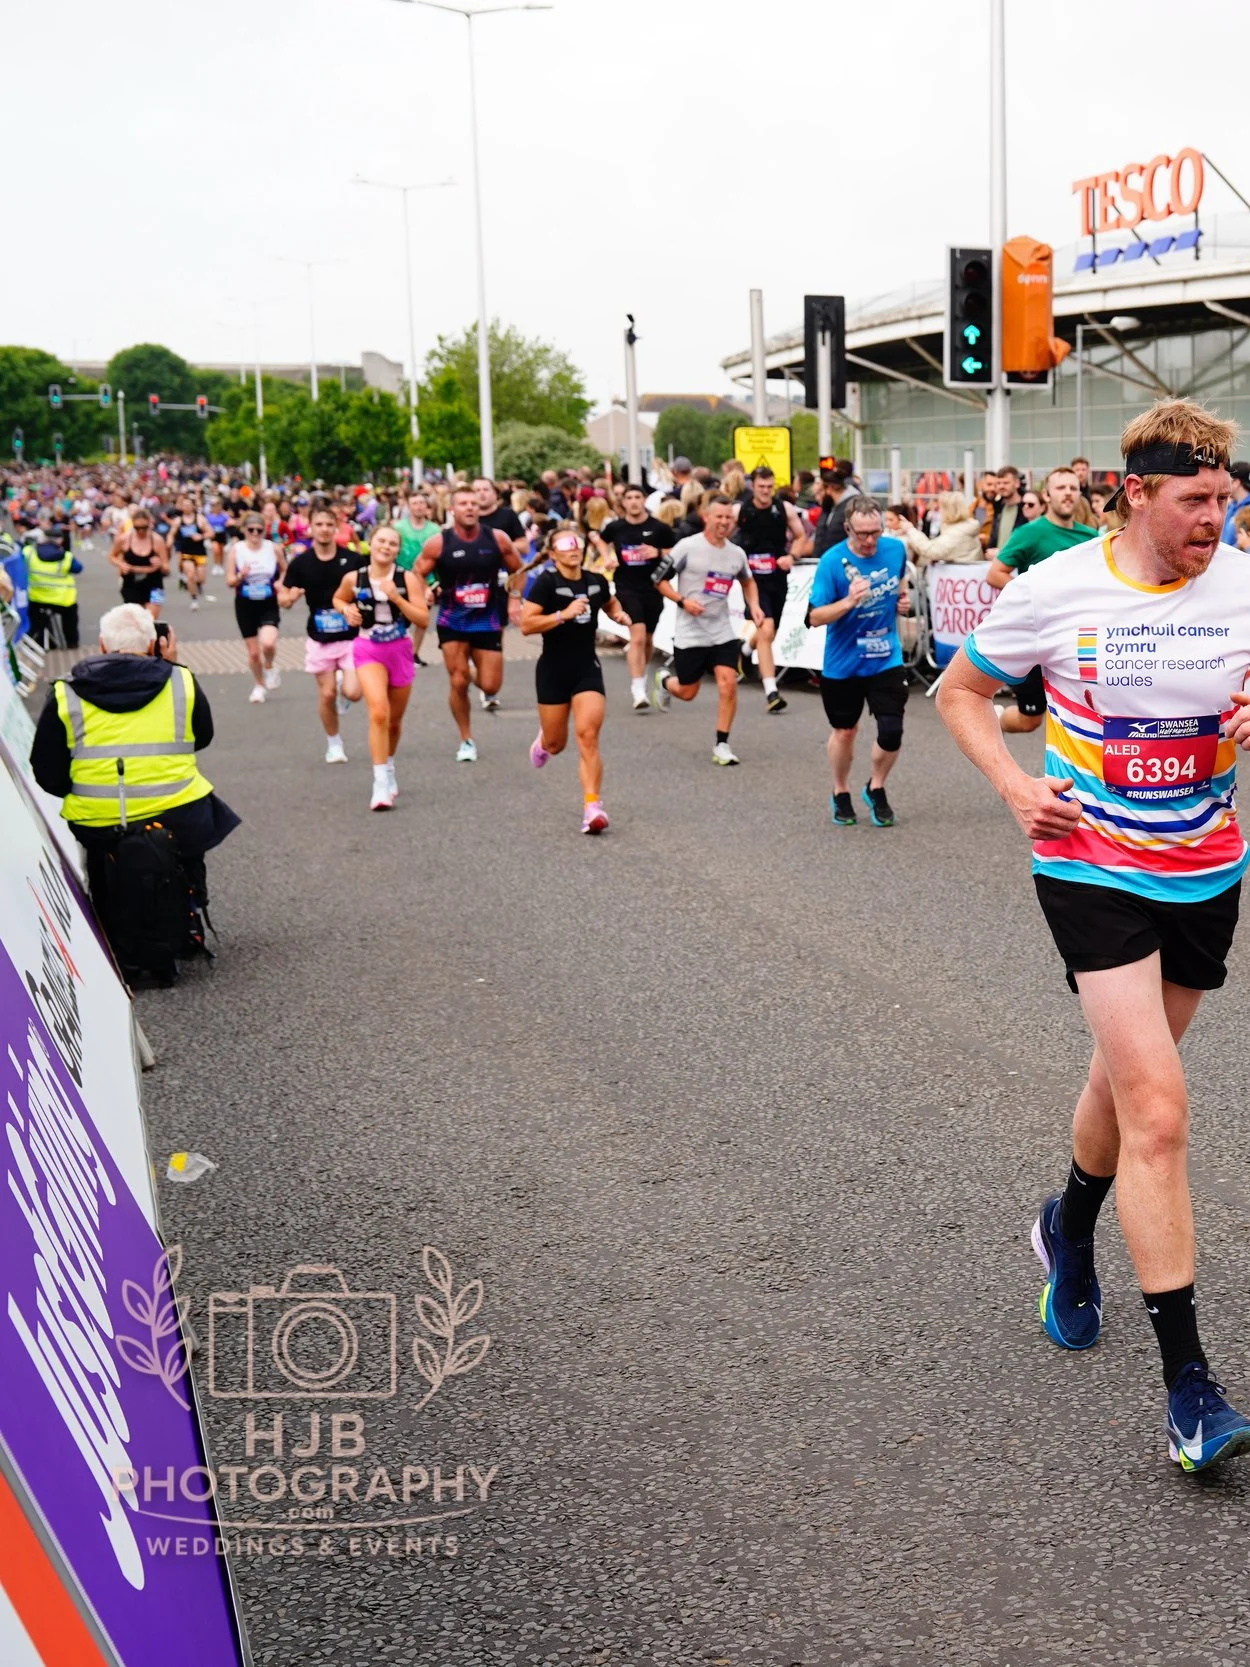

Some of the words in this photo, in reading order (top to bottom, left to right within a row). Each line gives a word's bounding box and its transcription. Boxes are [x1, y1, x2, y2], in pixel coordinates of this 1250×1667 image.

[1072, 147, 1203, 237] TESCO
[1106, 624, 1175, 639] ymchwil
[1178, 626, 1230, 637] canser
[1105, 641, 1157, 656] cymru
[1105, 658, 1159, 670] cancer
[1162, 656, 1226, 670] research
[1106, 674, 1153, 687] wales
[1160, 719, 1198, 729] SWANSEA
[1104, 744, 1140, 756] ALED
[1127, 754, 1196, 783] 6394
[1126, 786, 1194, 800] #RUNSWANSEA
